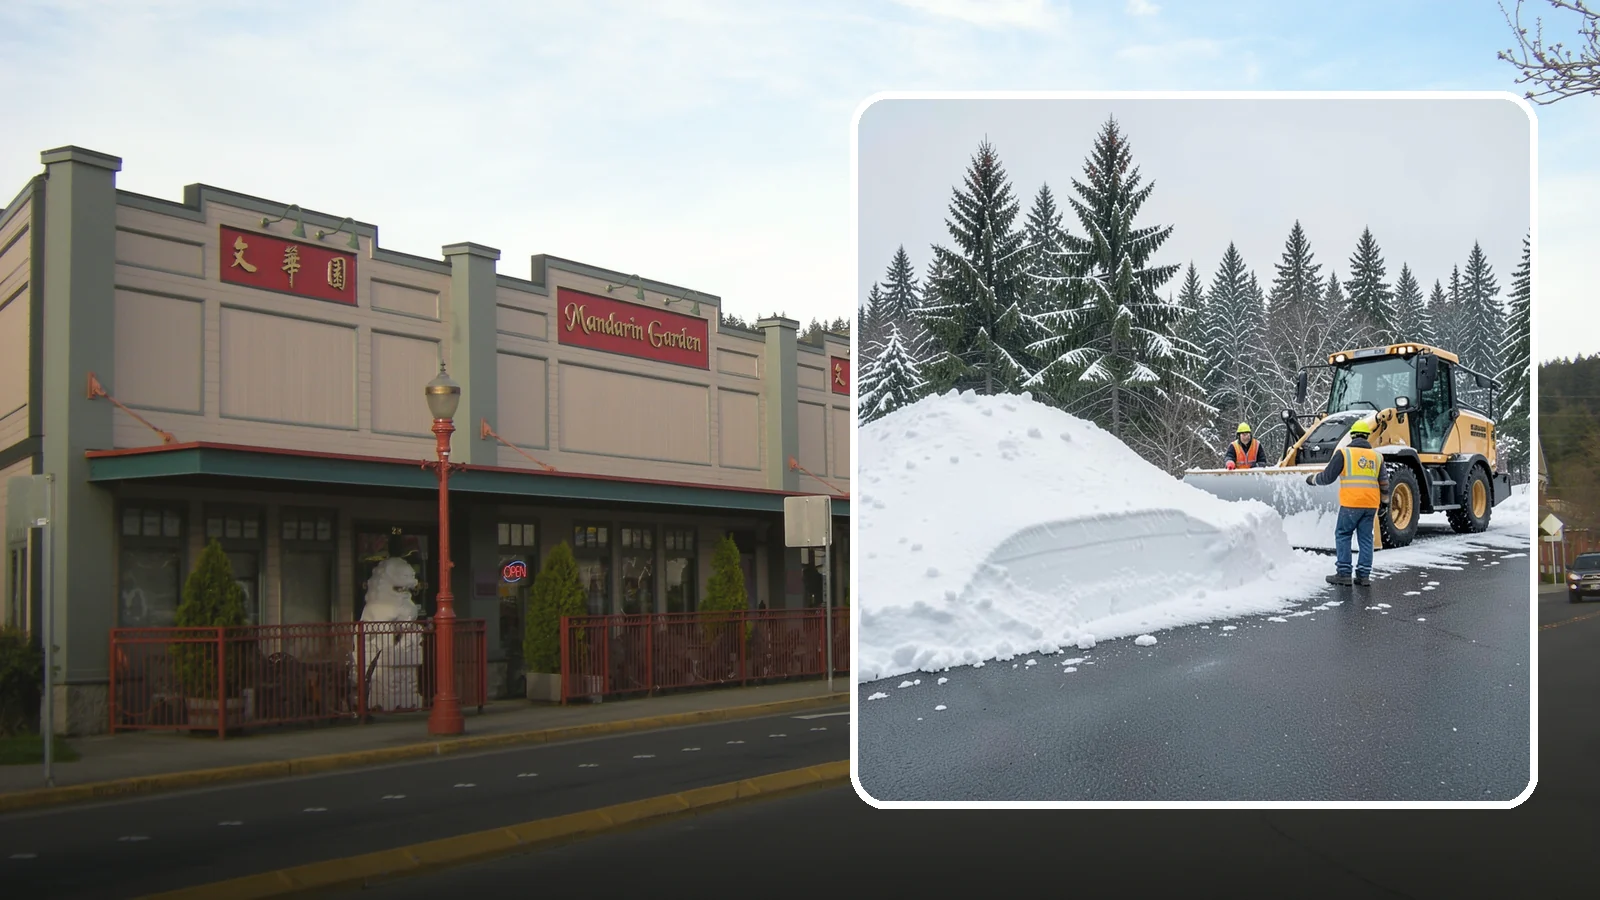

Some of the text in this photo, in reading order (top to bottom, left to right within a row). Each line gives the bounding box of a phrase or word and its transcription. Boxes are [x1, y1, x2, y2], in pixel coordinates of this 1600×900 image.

[231, 236, 346, 290] 文華園
[564, 302, 702, 352] Mandarin Garden
[834, 363, 846, 386] 文
[503, 565, 527, 578] OPEN
